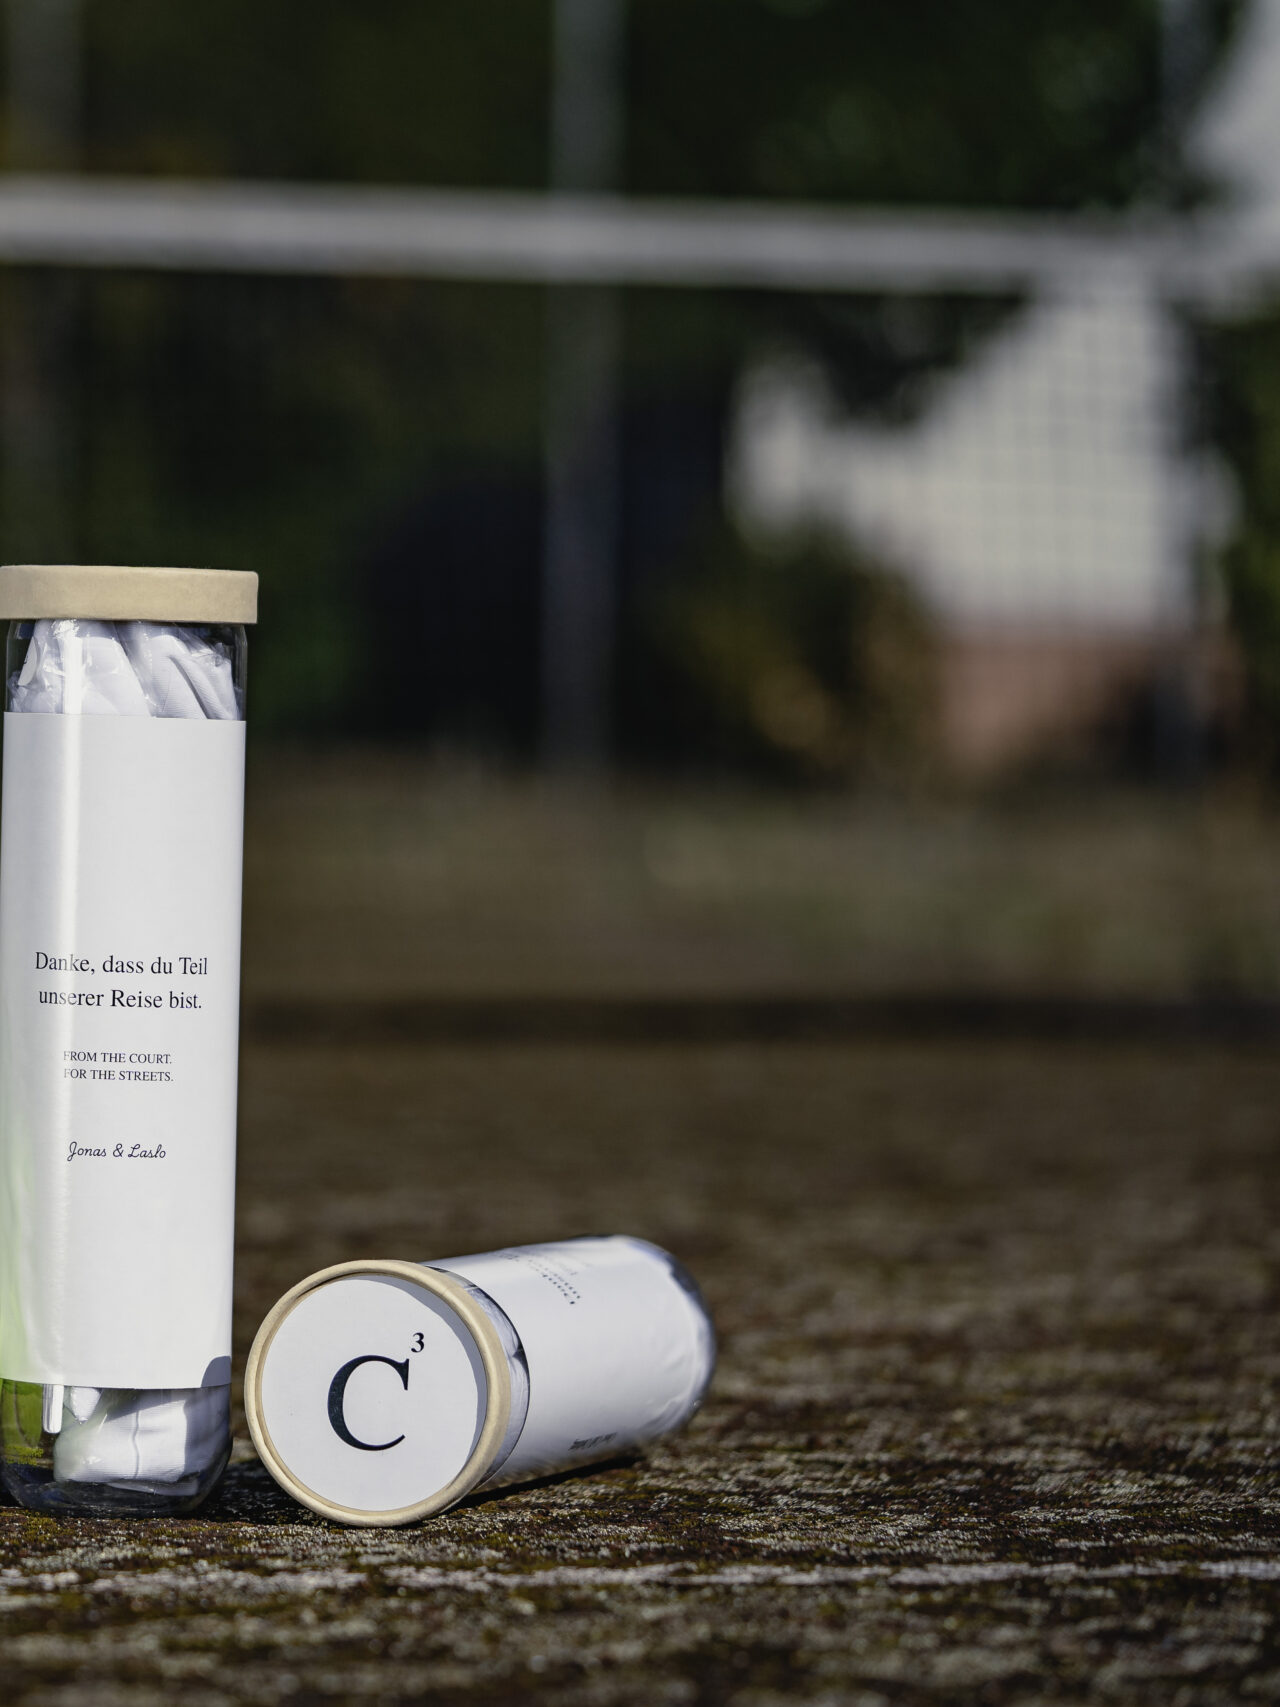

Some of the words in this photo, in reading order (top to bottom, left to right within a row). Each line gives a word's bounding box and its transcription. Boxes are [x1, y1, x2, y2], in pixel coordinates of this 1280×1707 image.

[35, 951, 96, 975] Danke,
[102, 955, 144, 974] dass
[150, 956, 173, 975] du
[178, 957, 208, 975] Teil
[38, 990, 105, 1007] unserer
[110, 989, 163, 1008] Reise
[169, 990, 202, 1009] bist.
[63, 1051, 98, 1062] FROM
[101, 1052, 126, 1063] THE
[129, 1053, 173, 1065] COURT.
[64, 1068, 87, 1079] FOR
[90, 1069, 116, 1080] THE
[118, 1070, 174, 1082] STREETS.
[67, 1141, 107, 1161] Jonas
[112, 1143, 124, 1158] &
[127, 1143, 167, 1159] Laslo
